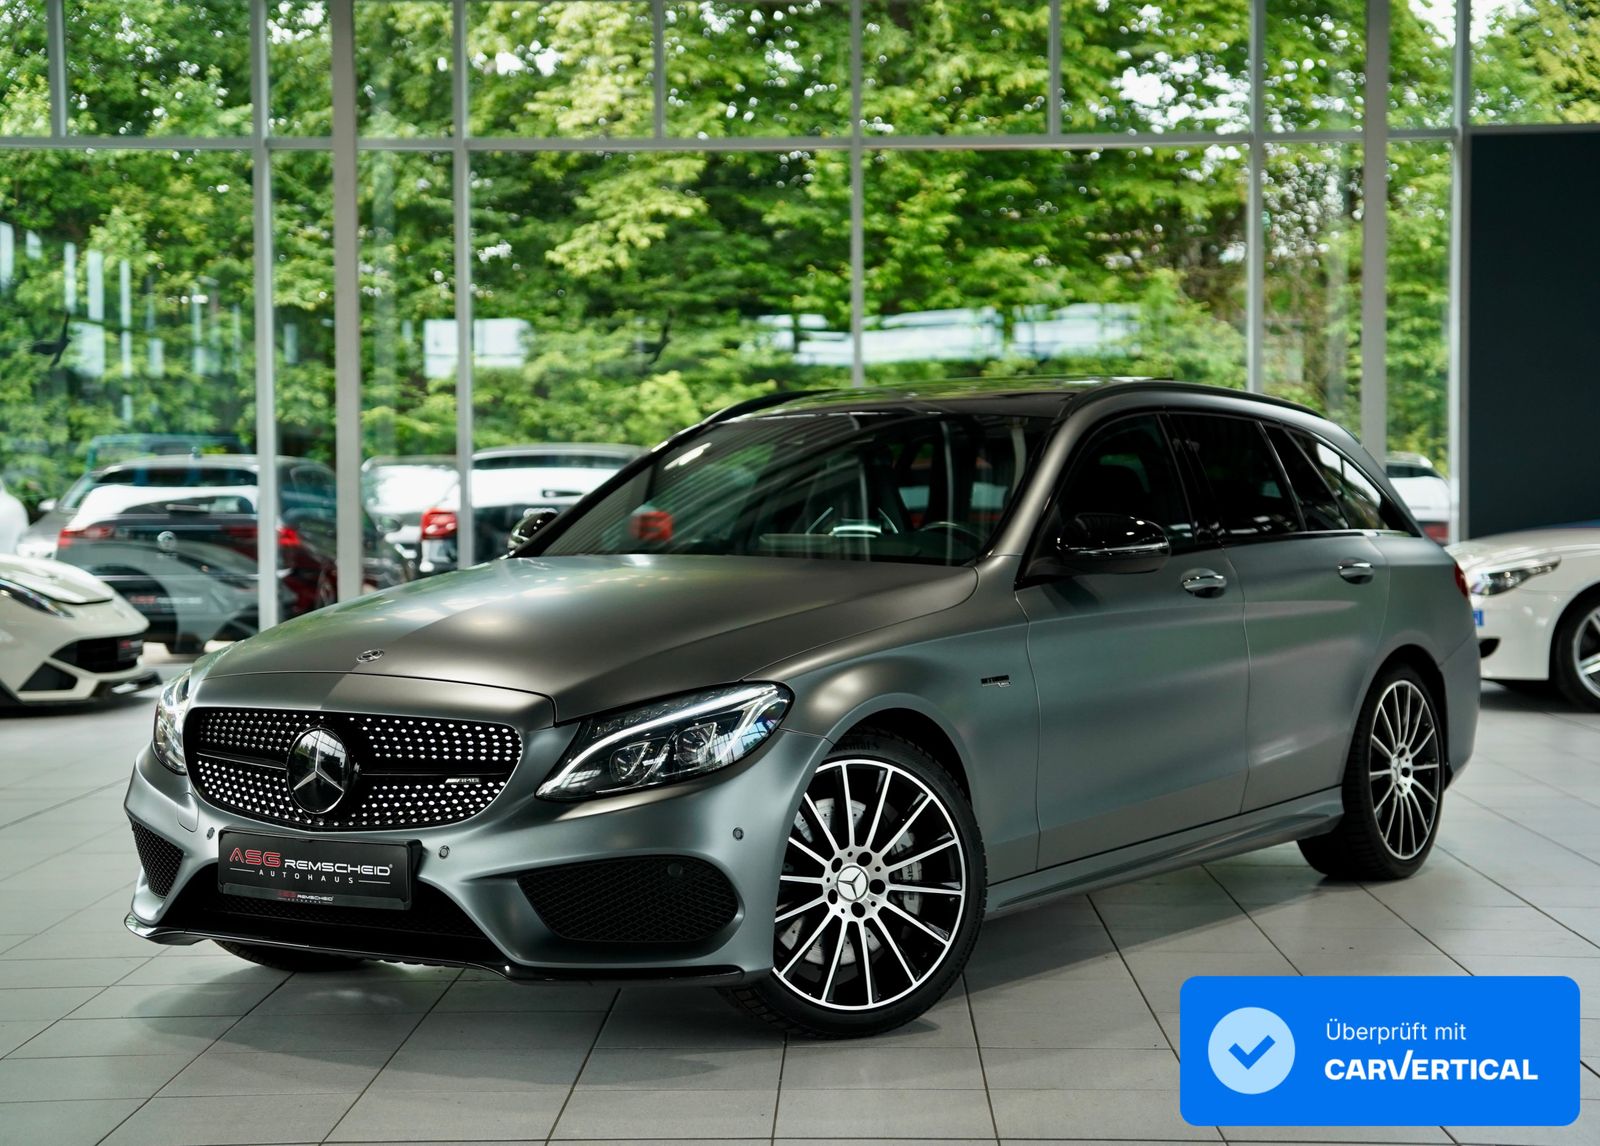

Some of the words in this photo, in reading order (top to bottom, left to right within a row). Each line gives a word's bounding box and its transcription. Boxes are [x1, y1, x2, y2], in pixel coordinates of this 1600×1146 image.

[229, 847, 281, 868] ASG
[284, 859, 391, 876] REMSCHEID
[259, 869, 354, 884] AUTOHAUS
